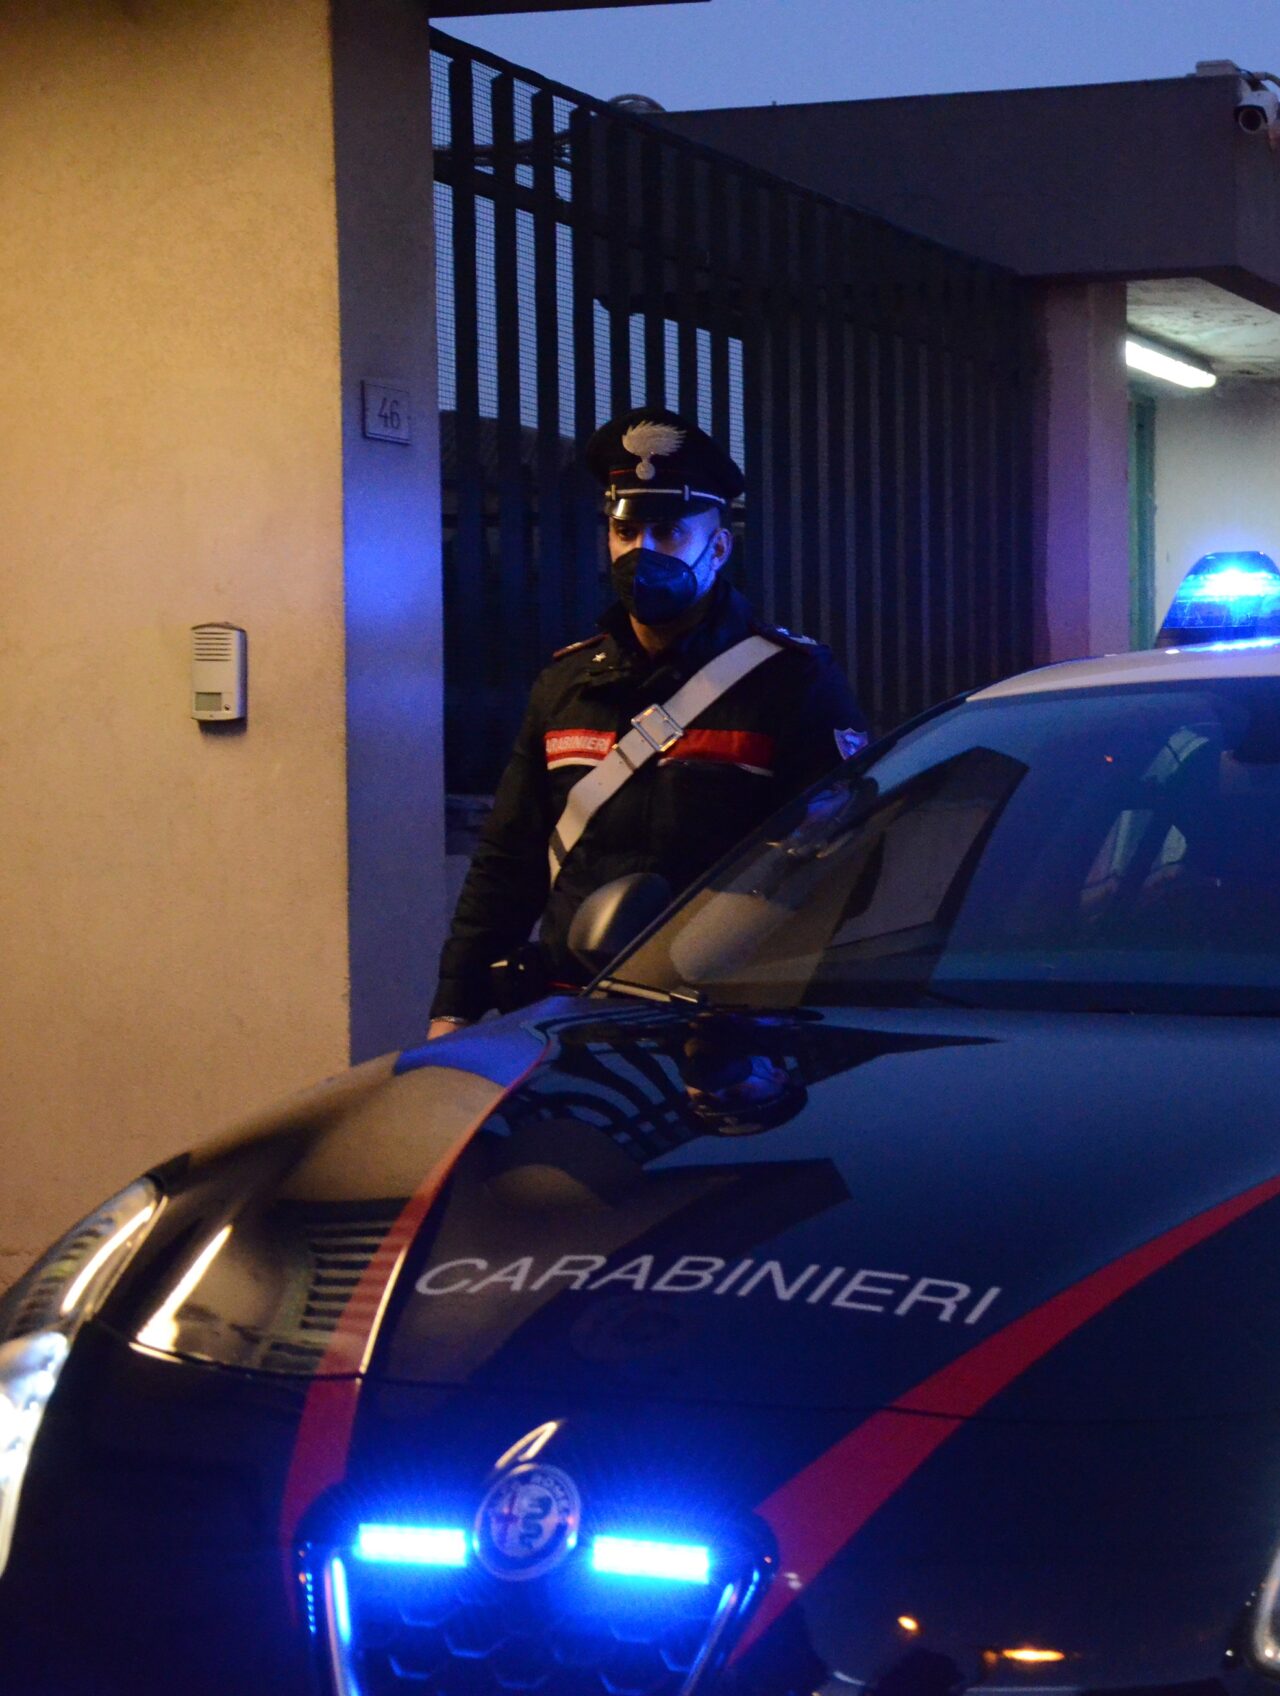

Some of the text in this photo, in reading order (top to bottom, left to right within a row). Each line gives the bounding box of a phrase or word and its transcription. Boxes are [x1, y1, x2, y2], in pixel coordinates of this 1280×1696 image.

[378, 397, 401, 430] 46
[546, 735, 612, 756] ARABINIERI
[415, 1254, 1002, 1325] CARABINIERI
